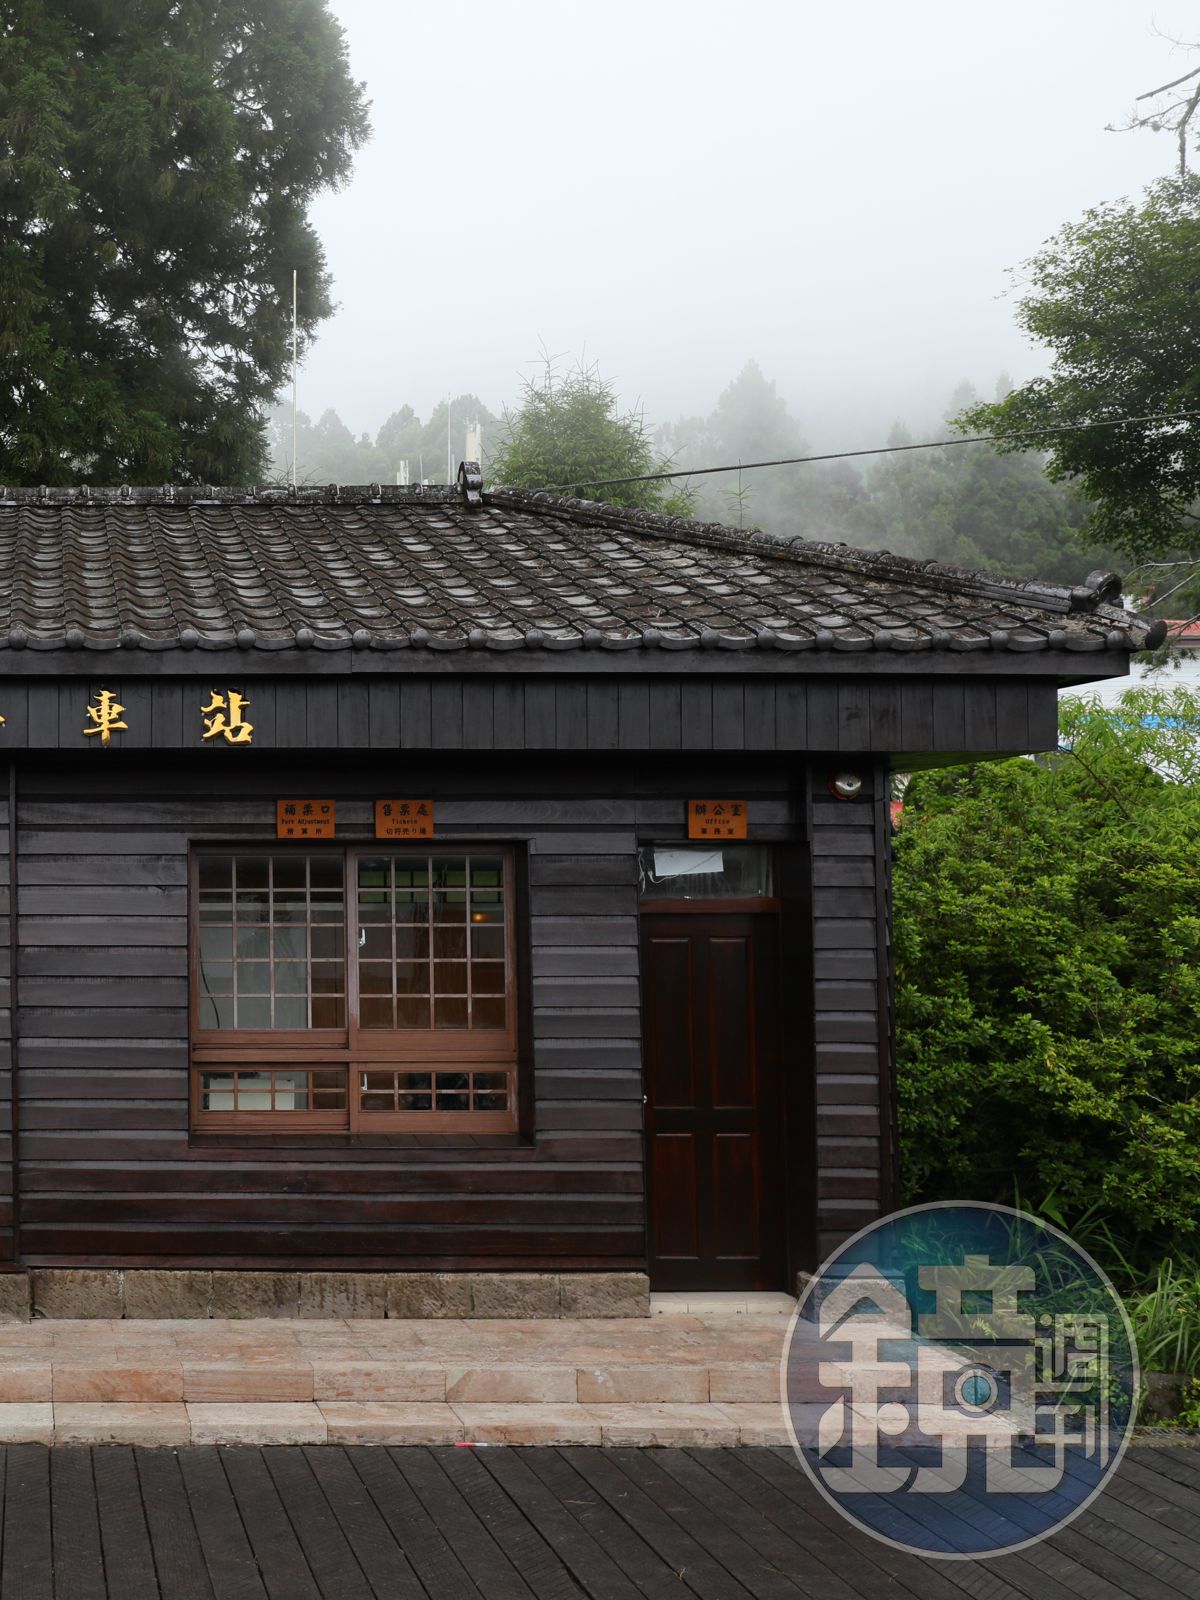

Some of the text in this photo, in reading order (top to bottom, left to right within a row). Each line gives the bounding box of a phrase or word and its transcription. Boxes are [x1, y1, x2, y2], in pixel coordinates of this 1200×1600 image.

[285, 803, 330, 816] 補票口
[383, 803, 430, 816] 售票處
[695, 803, 742, 816] 辦公室
